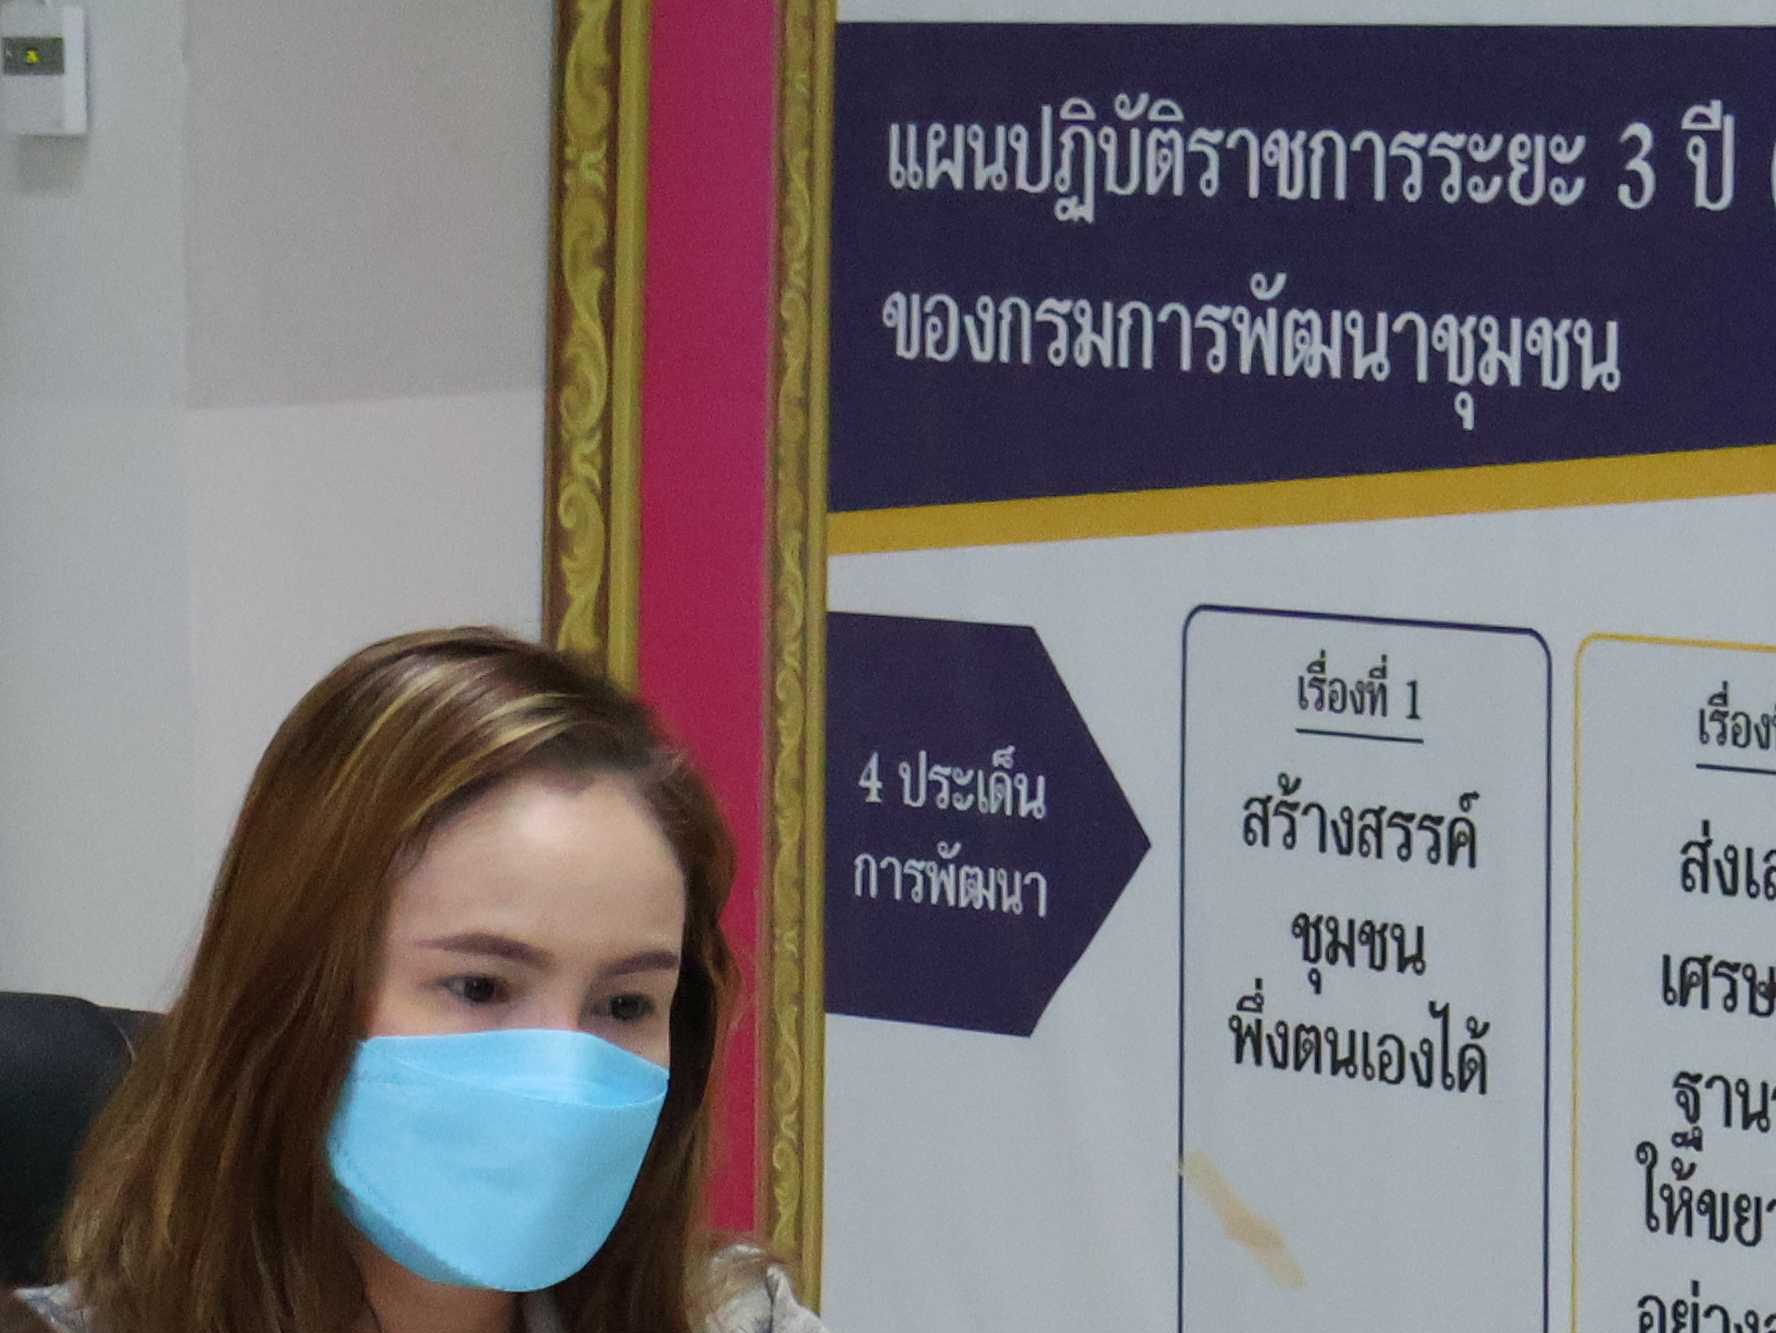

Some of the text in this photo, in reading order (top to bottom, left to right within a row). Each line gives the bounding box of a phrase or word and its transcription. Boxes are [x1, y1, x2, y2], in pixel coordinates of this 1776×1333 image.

[888, 92, 1587, 224] แผนปฏิบัติราชการระยะ
[1617, 121, 1656, 210] 3
[1680, 99, 1735, 211] ปี
[882, 272, 1621, 431] ของกรมการพัฒนาชุมชน
[1297, 648, 1421, 721] เรื่องที่ 1
[858, 745, 1047, 820] 4 ประเด็น
[1242, 772, 1481, 870] สร้างสรรค์
[853, 840, 1048, 918] การพัฒนา
[1290, 912, 1427, 996] ชุมชน
[1227, 974, 1491, 1096] พึ่งตนเองได้
